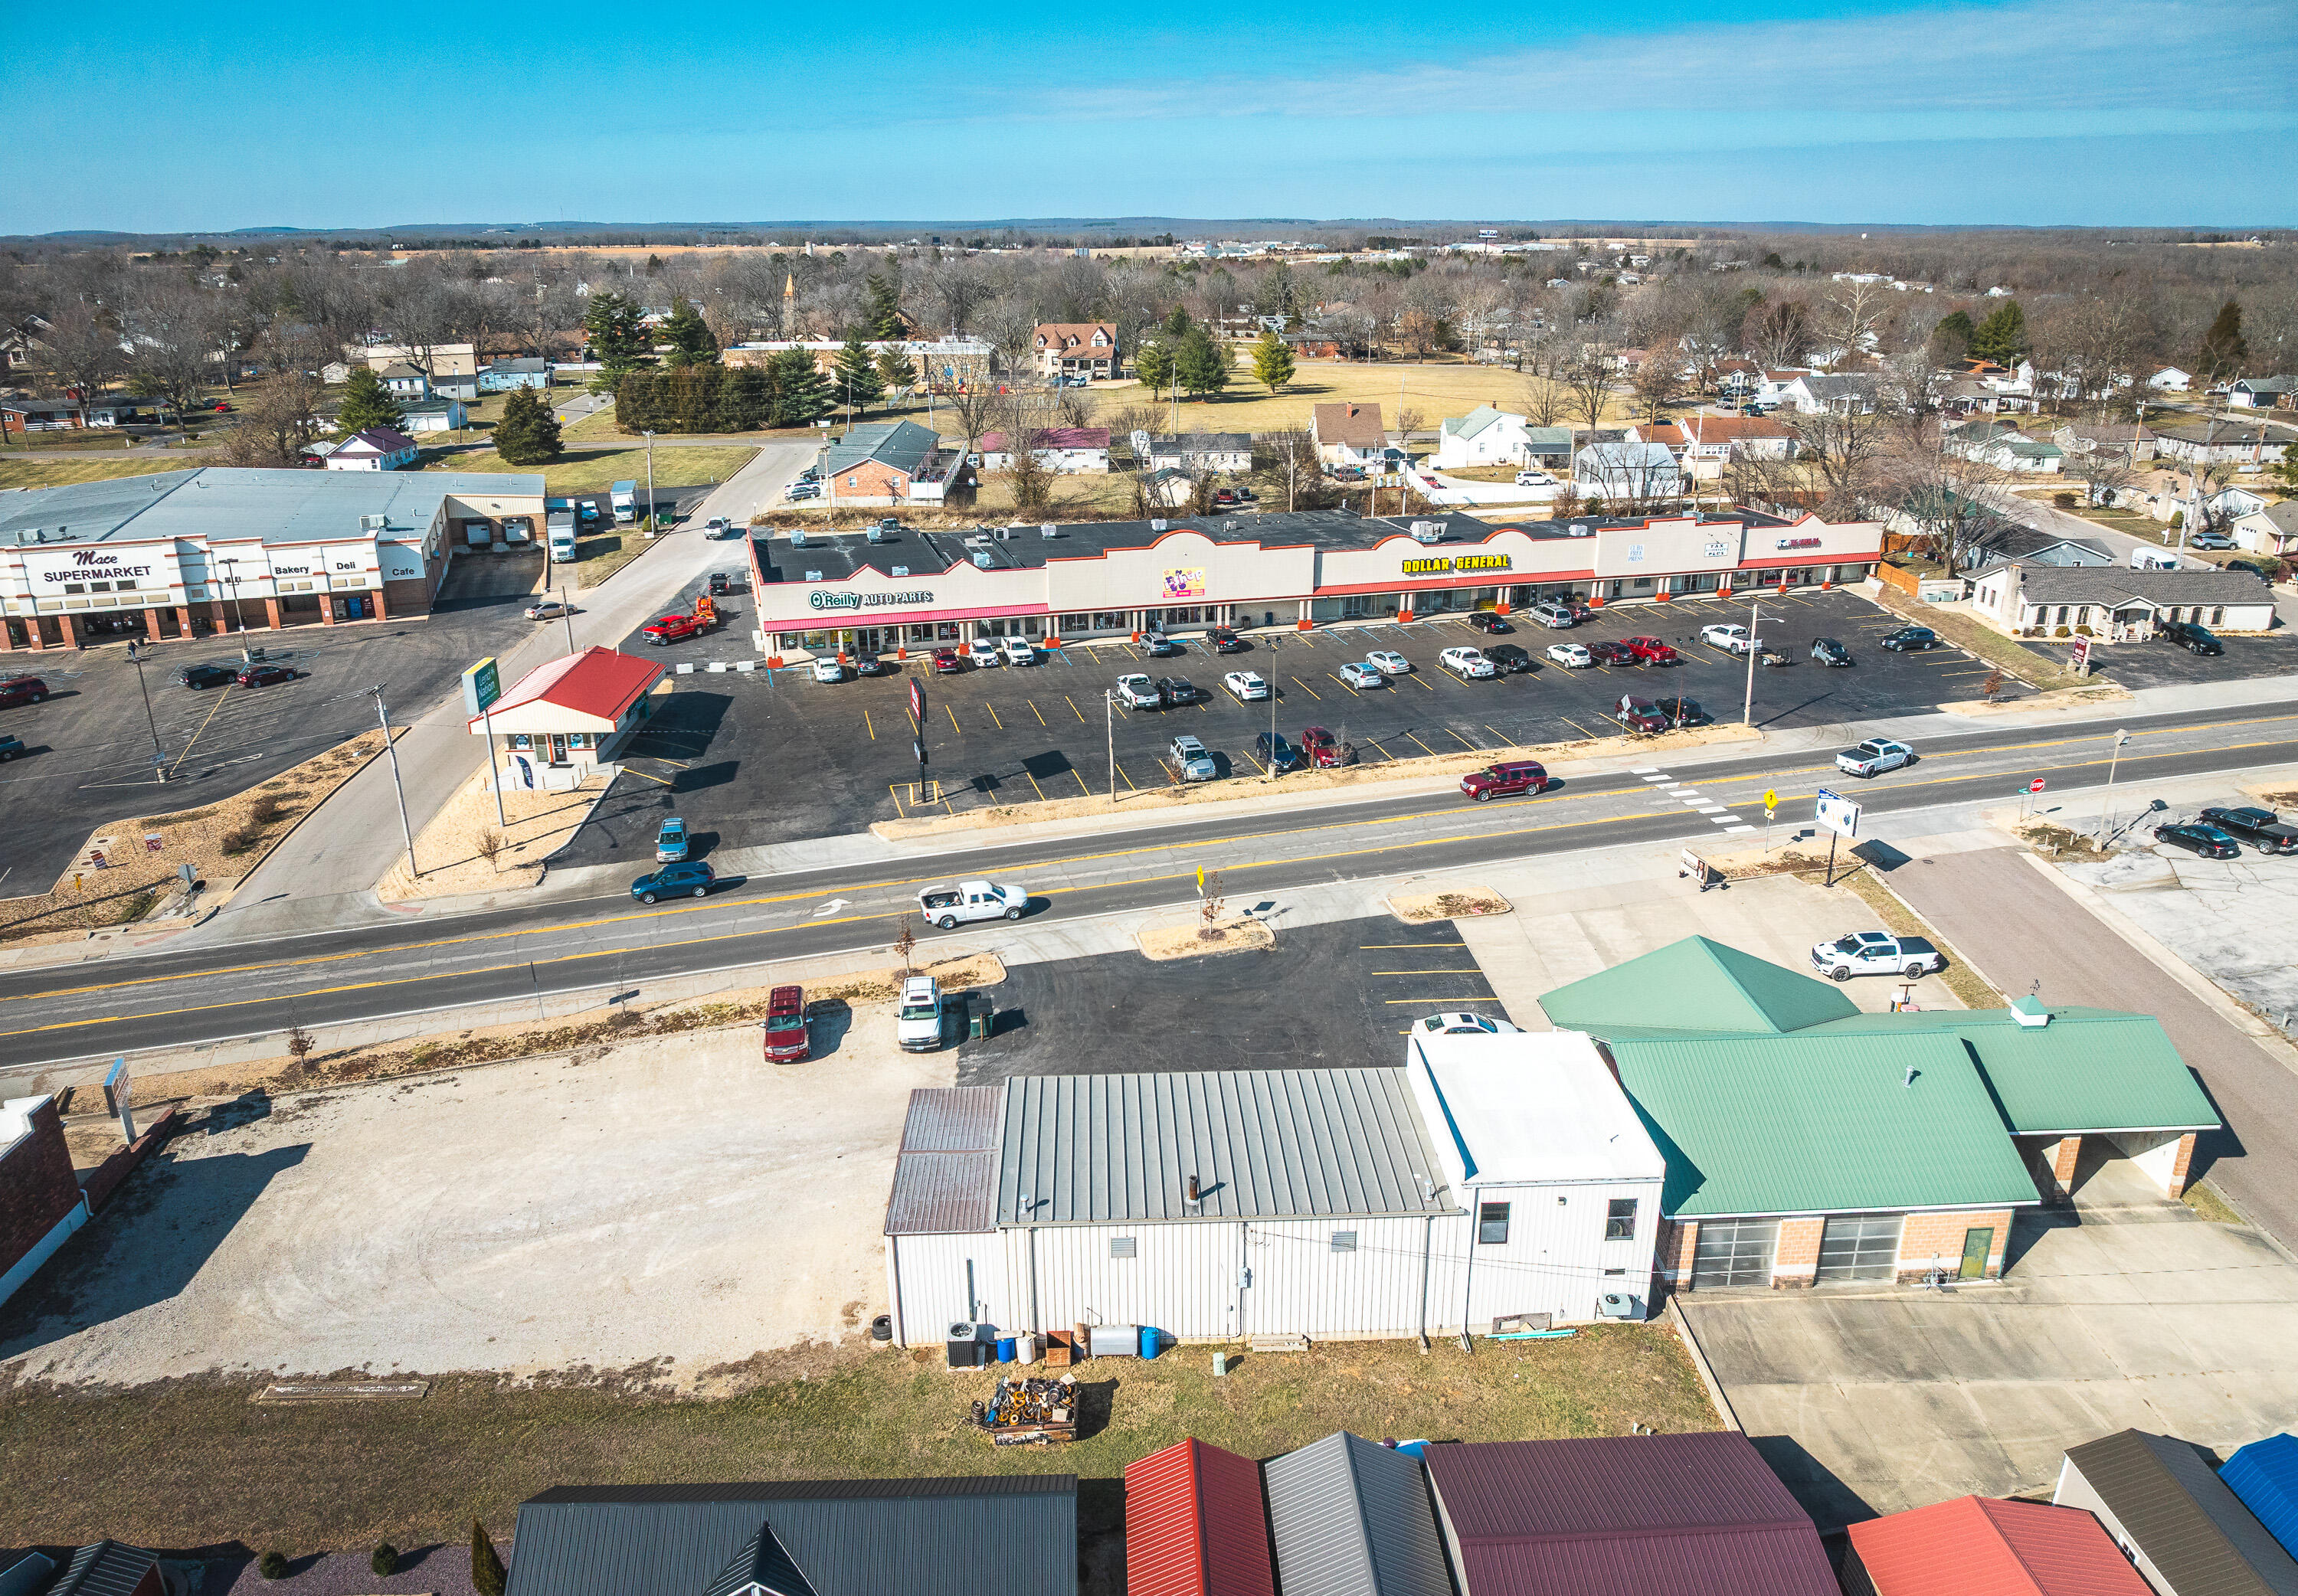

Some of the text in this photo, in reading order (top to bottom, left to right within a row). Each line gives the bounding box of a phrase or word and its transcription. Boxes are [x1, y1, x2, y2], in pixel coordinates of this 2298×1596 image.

[72, 551, 118, 566] Mace
[336, 561, 356, 571] Deli
[1403, 554, 1509, 573] DOLLAR GENERAL
[44, 565, 151, 582] SUPERMARKET
[275, 566, 309, 575] Bakery
[392, 567, 415, 577] Cafe
[809, 590, 931, 609] O'Reilly AUTO PARTS
[479, 669, 491, 686] Lend
[478, 681, 496, 699] Nation
